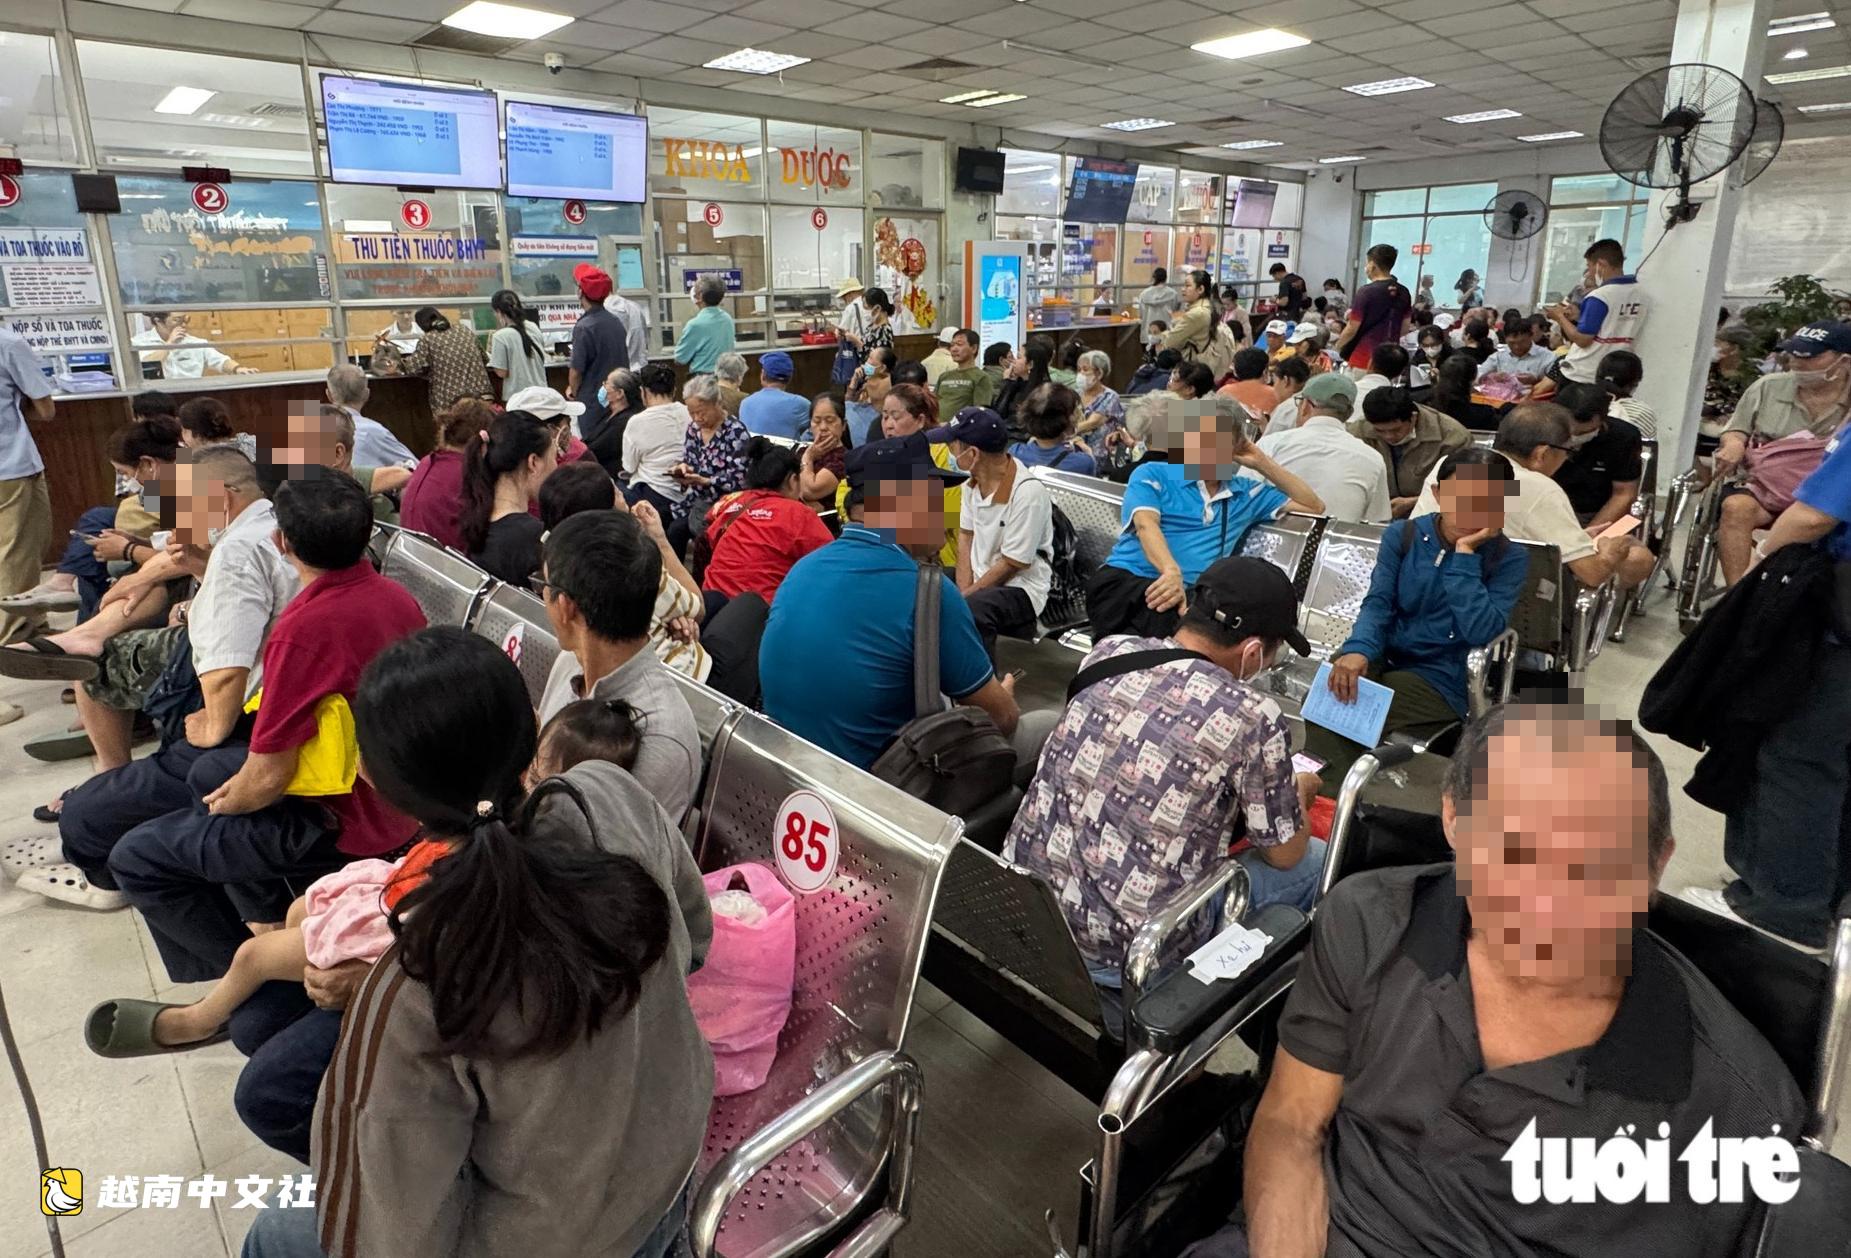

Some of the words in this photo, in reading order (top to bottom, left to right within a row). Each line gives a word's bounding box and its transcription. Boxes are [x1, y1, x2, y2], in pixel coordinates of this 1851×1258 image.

[663, 138, 751, 182] KHOA
[780, 145, 852, 194] DƯỢC
[202, 188, 221, 208] 2
[409, 204, 424, 226] 3
[570, 204, 583, 220] 4
[9, 240, 28, 257] TOA
[27, 234, 55, 257] THUỐC
[55, 236, 71, 257] VÀO
[72, 233, 84, 257] RỔ
[352, 237, 379, 260] THU
[381, 227, 411, 260] TIỀN
[413, 231, 455, 260] THUỐC
[456, 239, 486, 260] BHYT
[12, 319, 29, 334] NỘP
[32, 316, 43, 332] SỔ
[45, 318, 57, 331] VÀ
[57, 320, 75, 331] TOA
[76, 316, 103, 331] THUỐC
[781, 811, 832, 873] 85
